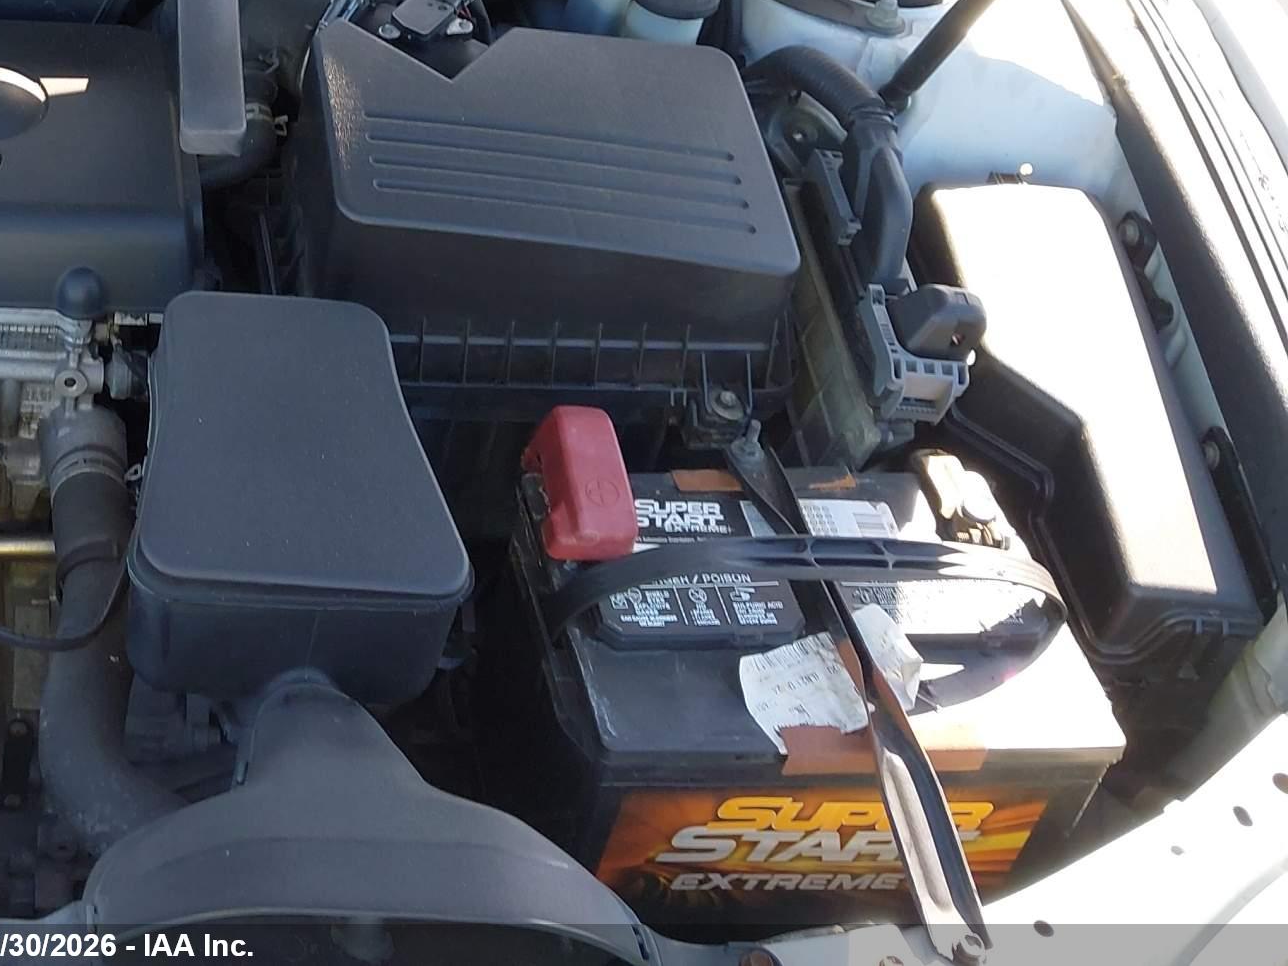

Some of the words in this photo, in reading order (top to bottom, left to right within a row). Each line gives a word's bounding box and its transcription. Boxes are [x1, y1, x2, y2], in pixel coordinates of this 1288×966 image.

[634, 498, 721, 516] SUPER
[636, 513, 725, 528] START
[706, 797, 995, 831] SUPR
[655, 826, 981, 864] STAR
[671, 873, 905, 891] EXTREME
